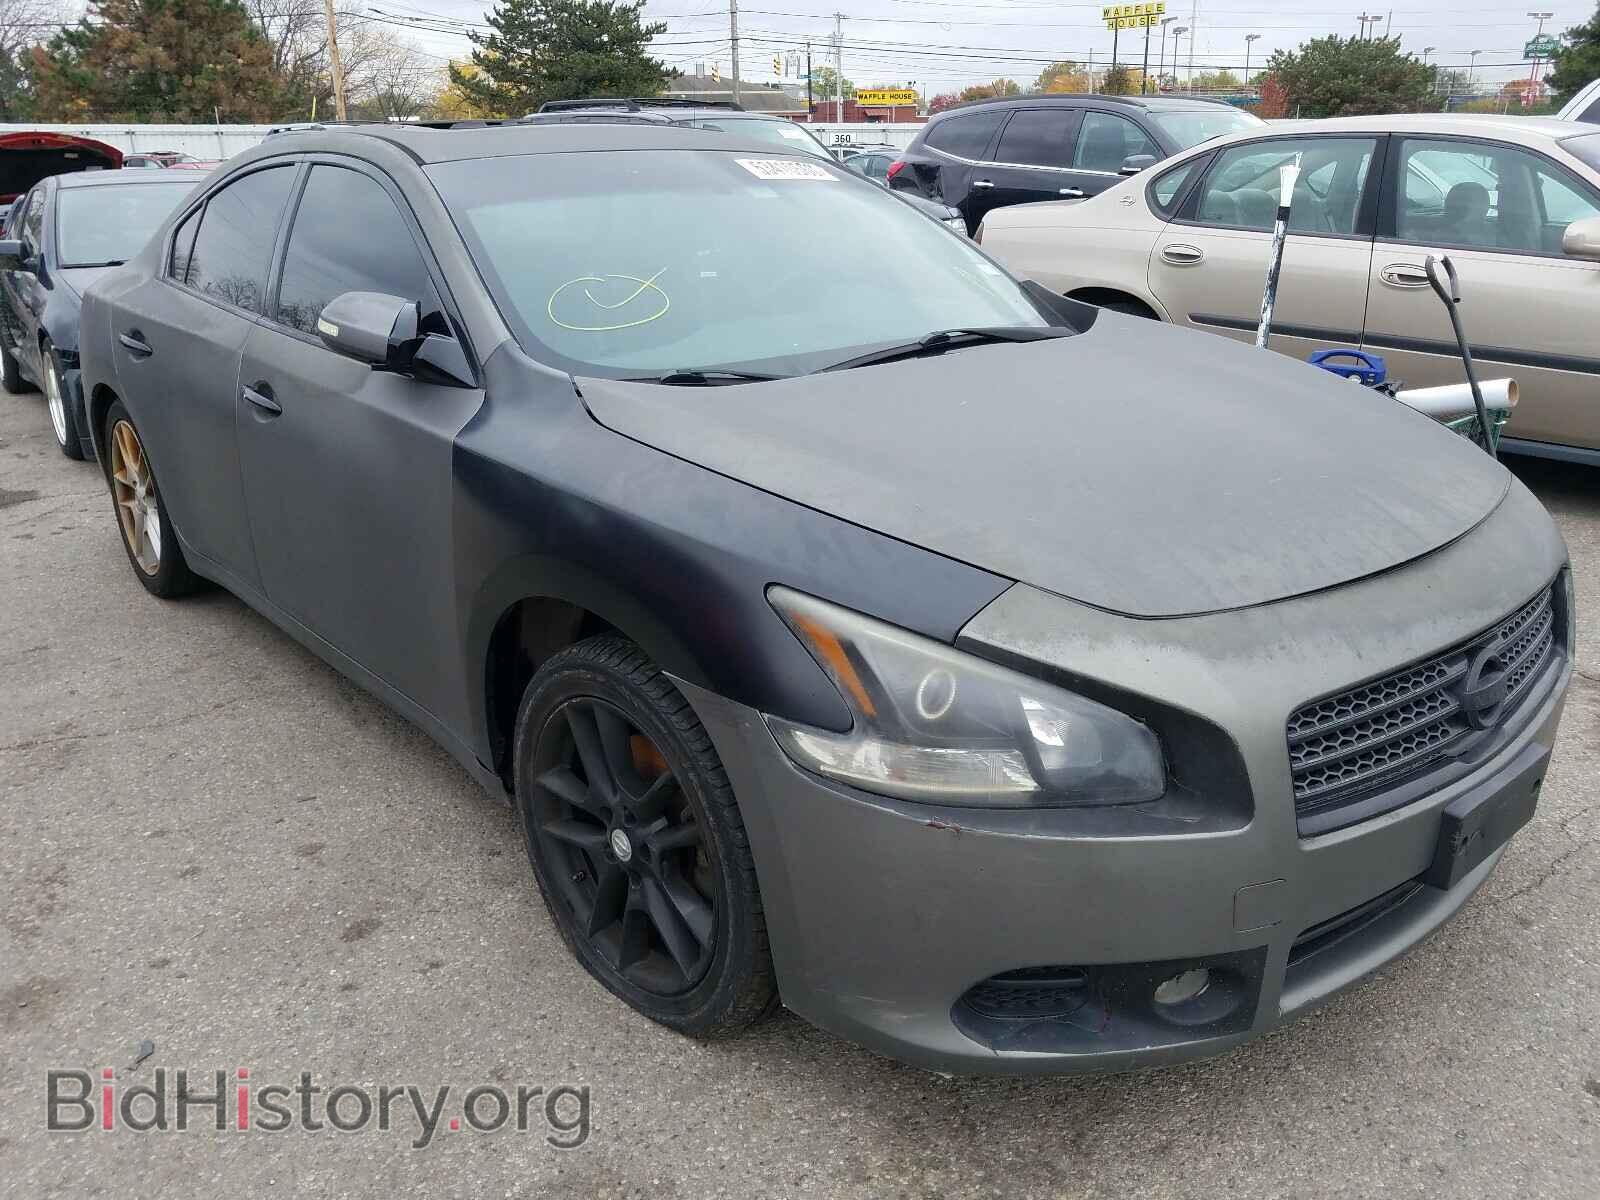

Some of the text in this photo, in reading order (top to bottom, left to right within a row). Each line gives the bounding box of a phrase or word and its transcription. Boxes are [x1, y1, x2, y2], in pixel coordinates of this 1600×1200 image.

[1103, 3, 1163, 17] WAFFLE
[1108, 16, 1157, 29] HOUSE
[834, 134, 851, 143] 360
